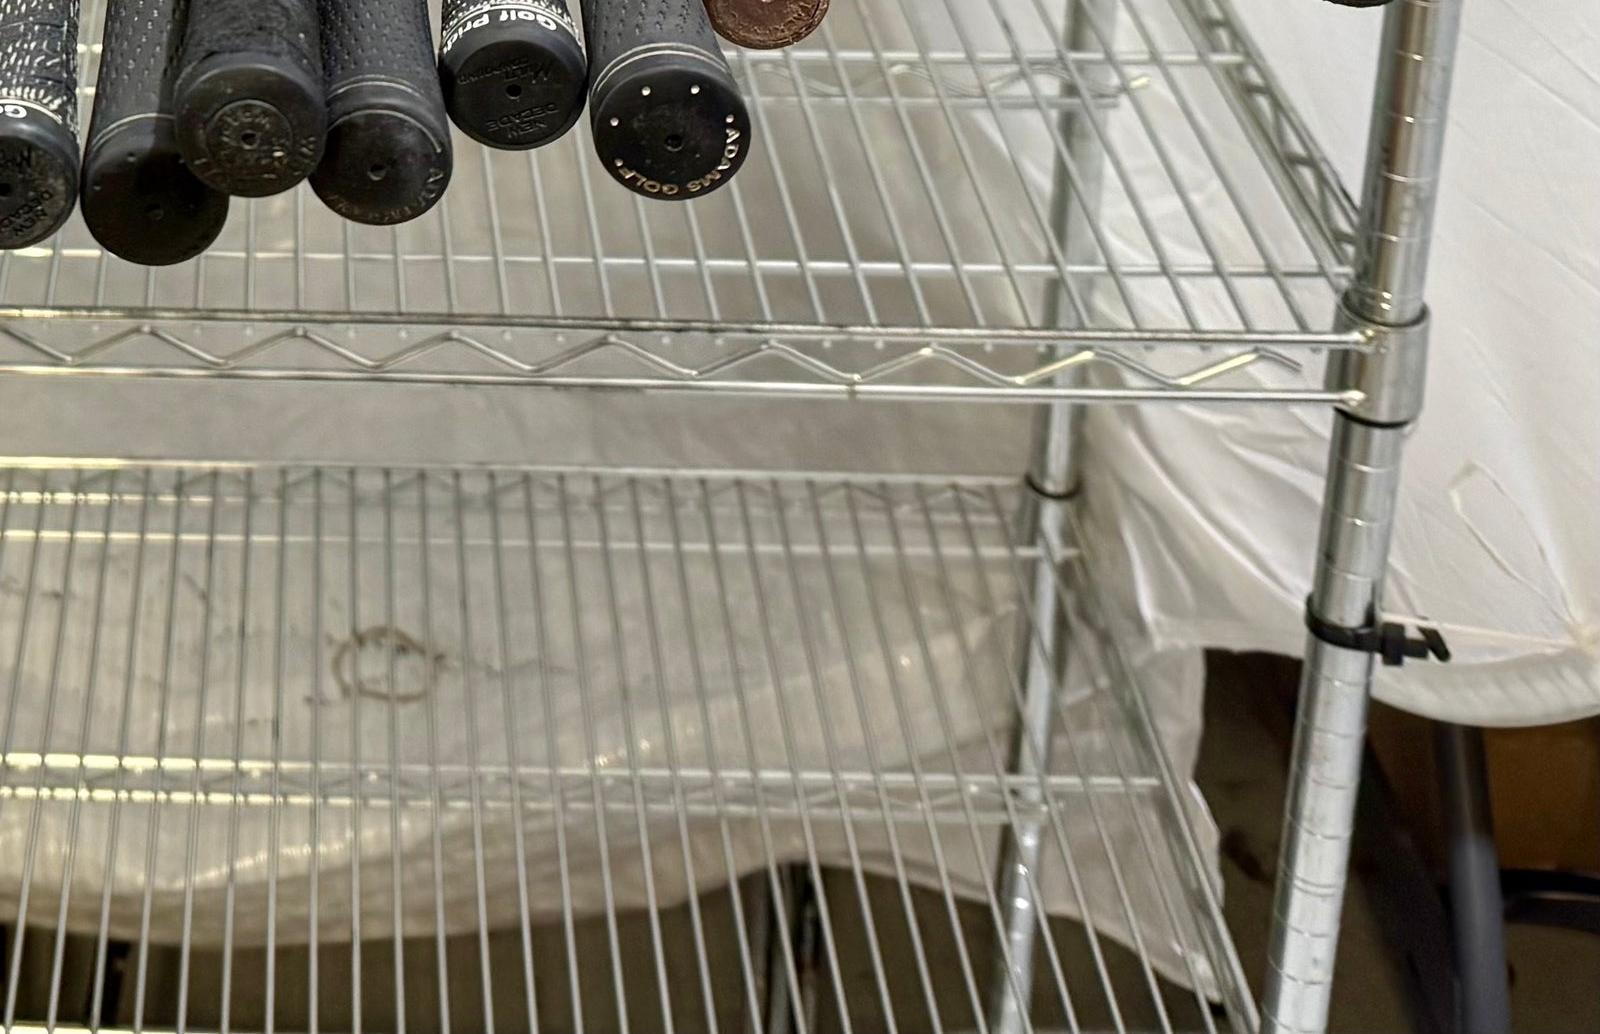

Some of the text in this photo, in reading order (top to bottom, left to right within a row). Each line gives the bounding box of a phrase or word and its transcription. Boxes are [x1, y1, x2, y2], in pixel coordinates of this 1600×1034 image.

[440, 10, 557, 53] Golf Prid
[484, 102, 558, 132] DECADE
[619, 127, 741, 196] ADAMS GOLF
